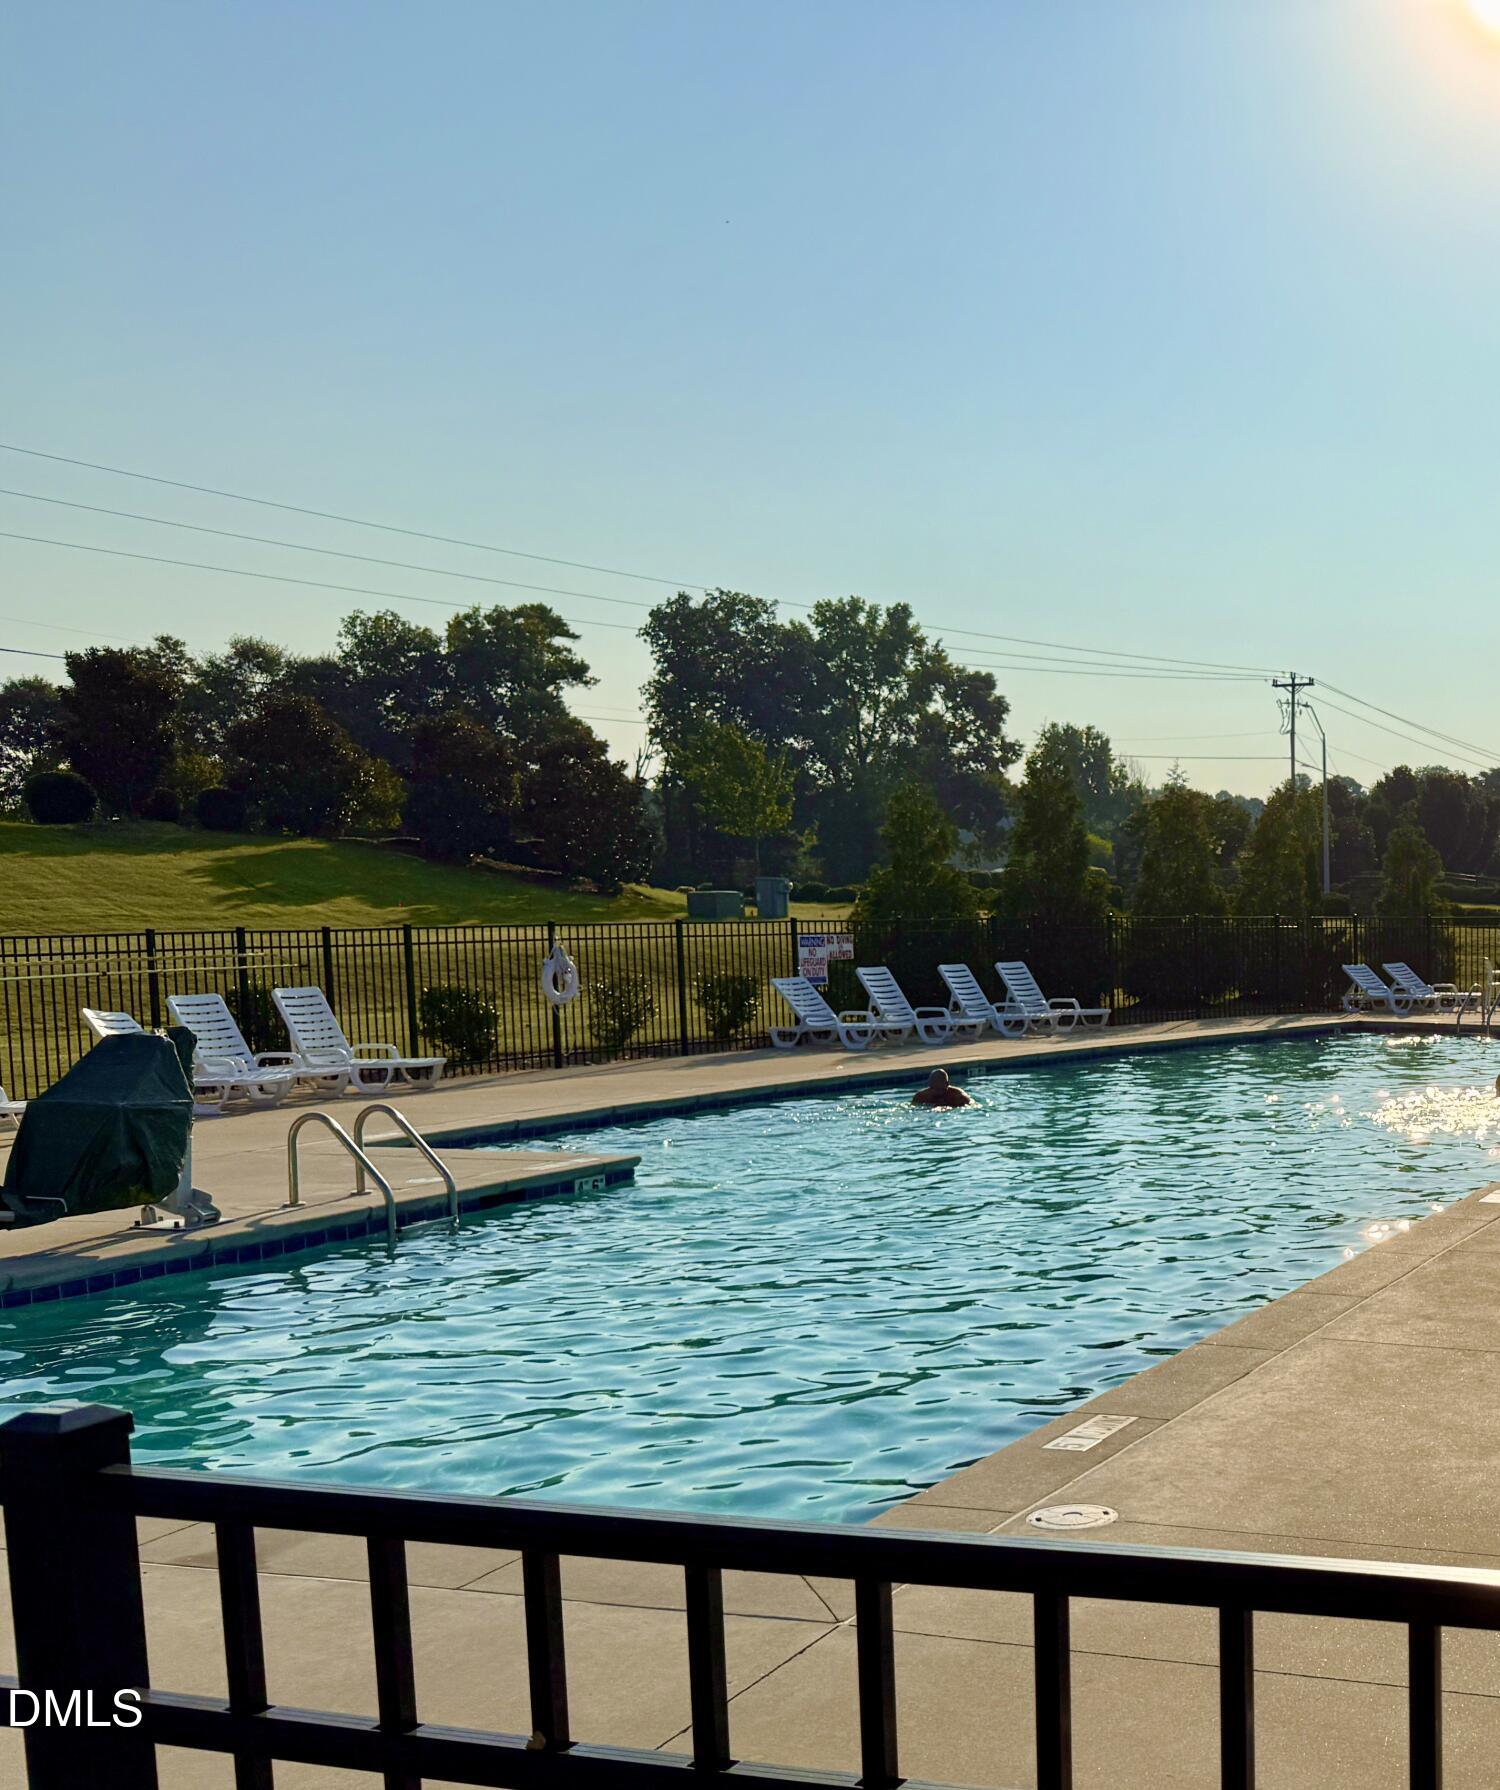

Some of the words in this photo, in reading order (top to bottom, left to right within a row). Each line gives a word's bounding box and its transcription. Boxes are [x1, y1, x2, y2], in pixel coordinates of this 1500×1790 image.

[808, 948, 816, 957] NO
[803, 968, 811, 976] ON
[812, 968, 824, 976] DUTY
